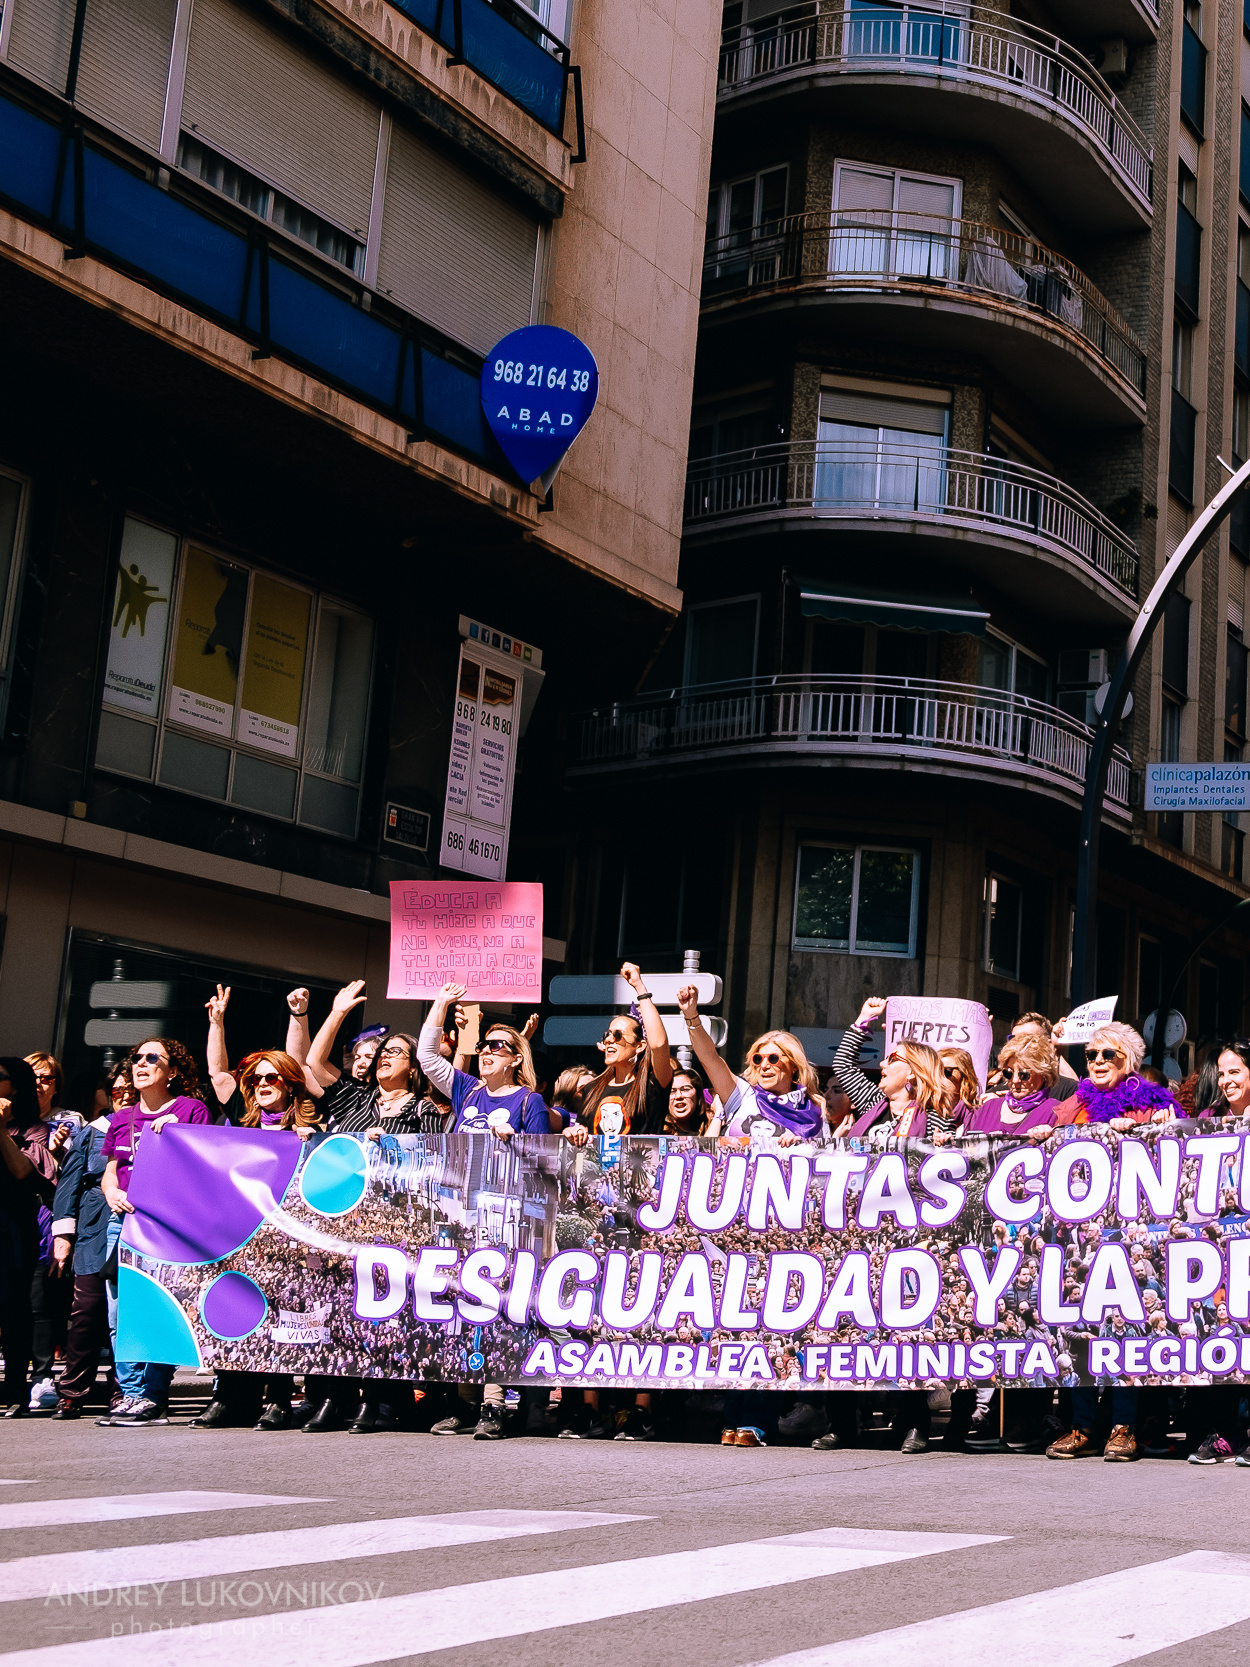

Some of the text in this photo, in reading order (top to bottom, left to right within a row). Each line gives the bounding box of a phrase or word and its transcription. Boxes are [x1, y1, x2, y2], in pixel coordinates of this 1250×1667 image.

[494, 360, 590, 392] 968 21 64 38
[497, 406, 574, 426] ABAD
[512, 423, 556, 434] HOME
[457, 702, 475, 722] 968
[1154, 785, 1245, 796] Implantes Dentales
[1154, 796, 1246, 808] Cirugía Maxilofacial
[448, 831, 464, 850] 686
[485, 893, 502, 909] A
[482, 915, 496, 928] A
[501, 915, 536, 930] QUE
[401, 935, 428, 950] NO
[484, 936, 504, 948] NO
[511, 936, 524, 948] A
[402, 954, 430, 968] TU
[486, 954, 498, 968] A
[502, 954, 536, 970] QUE
[406, 971, 456, 988] LLEVE
[888, 998, 942, 1020] SOMOS
[891, 1020, 970, 1043] FUERTES
[637, 1151, 970, 1233] JUNTAS
[353, 1244, 941, 1332] DESIGUALDAD
[958, 1243, 1022, 1327] Y
[1038, 1241, 1146, 1326] LA
[280, 1320, 307, 1330] MUJERES
[290, 1312, 317, 1322] LIBRES
[288, 1330, 320, 1340] VIVAS
[523, 1339, 776, 1380] ASAMBLEA
[804, 1340, 1058, 1380] FEMINISTA
